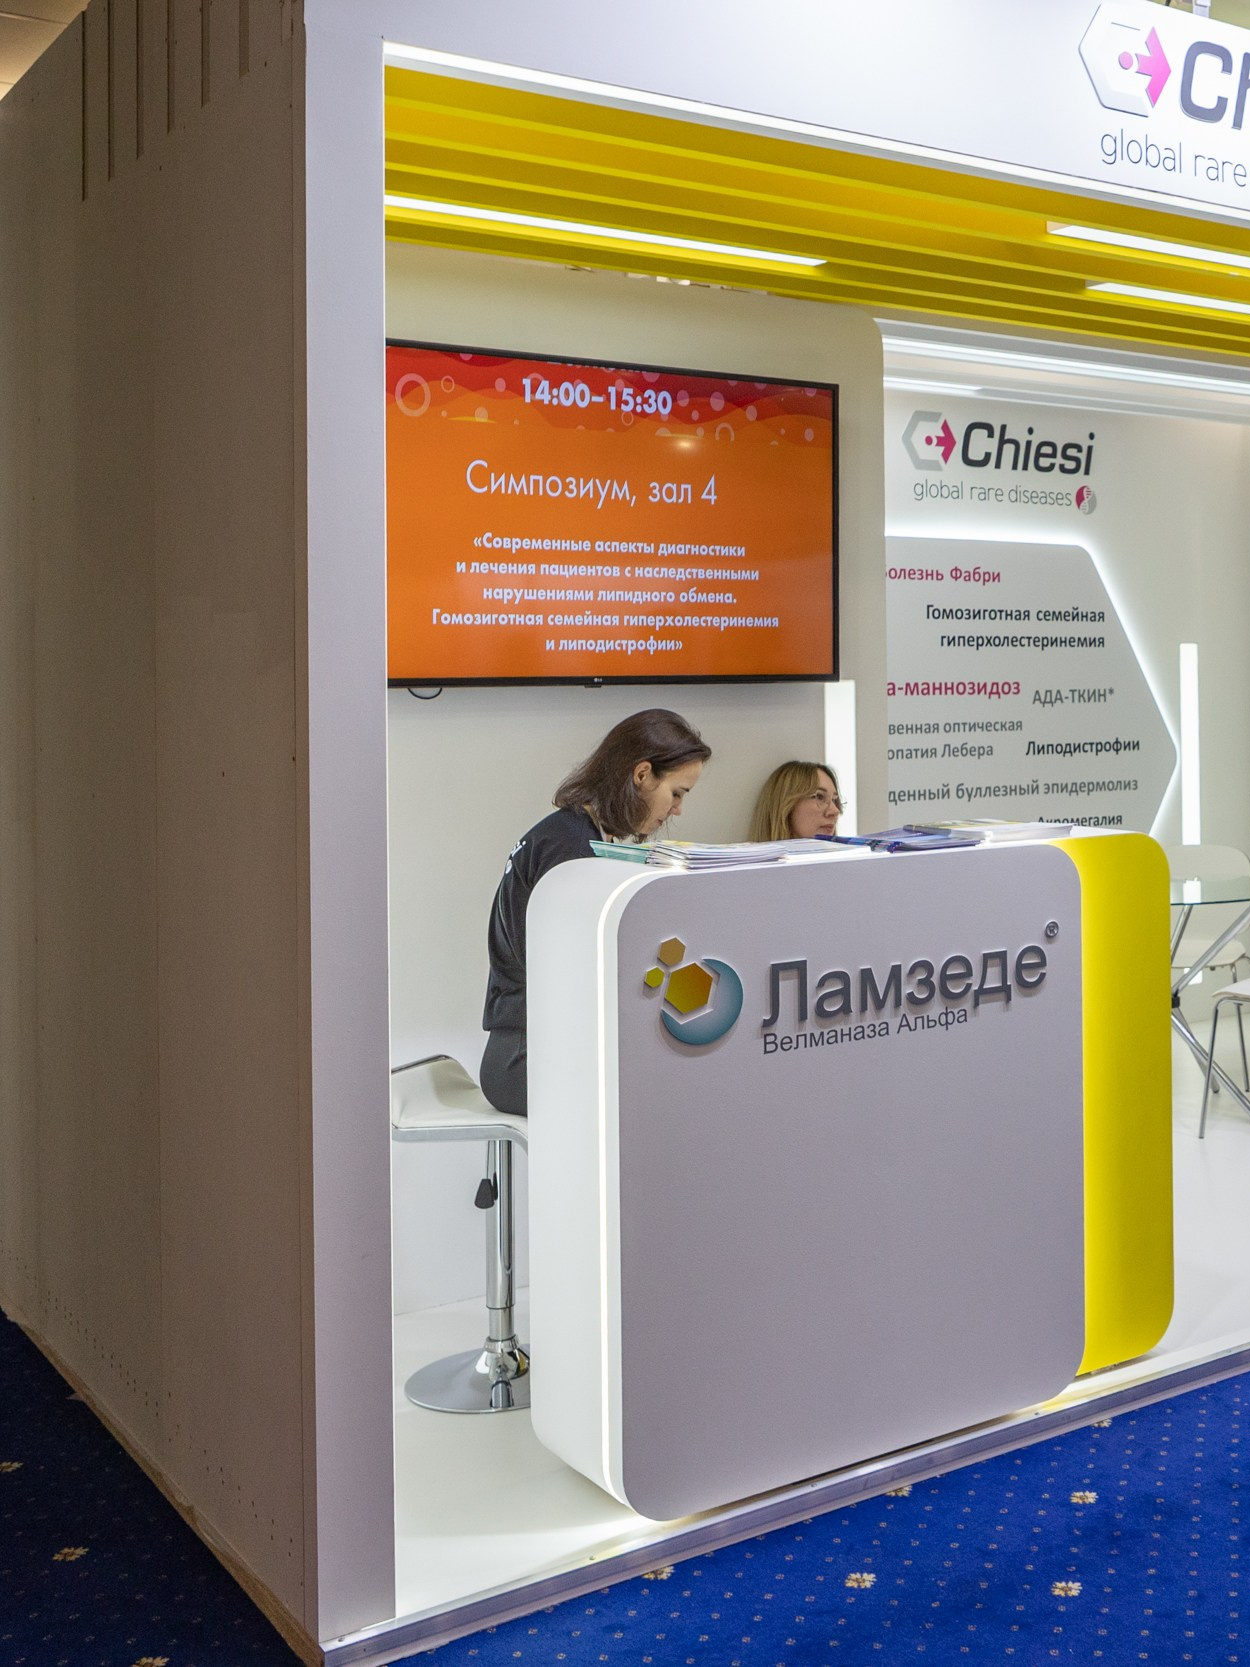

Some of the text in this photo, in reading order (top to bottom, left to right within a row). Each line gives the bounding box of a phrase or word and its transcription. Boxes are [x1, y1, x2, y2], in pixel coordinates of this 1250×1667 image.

[1100, 128, 1183, 174] global
[1193, 152, 1248, 188] rare
[961, 421, 1096, 476] Chiesi
[465, 459, 718, 510] Симпозиум, зал 4
[913, 479, 1073, 507] global rare diseases
[473, 531, 746, 557] «Современные аспекты диагностики
[456, 561, 760, 581] и лечения пациентов с наследственными
[885, 565, 1001, 586] олезнь Фабри
[482, 586, 738, 605] нарушениями липидного обмена.
[431, 608, 780, 632] Гомозиготная семейная гиперхолестеринемия
[925, 604, 1105, 623] Гомозиготная семейная
[545, 635, 684, 656] и липодистрофии»
[940, 634, 1105, 652] гиперхолестеринемия
[886, 680, 1021, 700] а-маннозидоз
[943, 719, 1023, 735] оптическая
[940, 742, 994, 761] Лебера
[1025, 735, 1141, 759] Липодистрофии
[888, 778, 1139, 806] денный буллезный эпидермолиз
[763, 1005, 970, 1055] Велманаза Альфа
